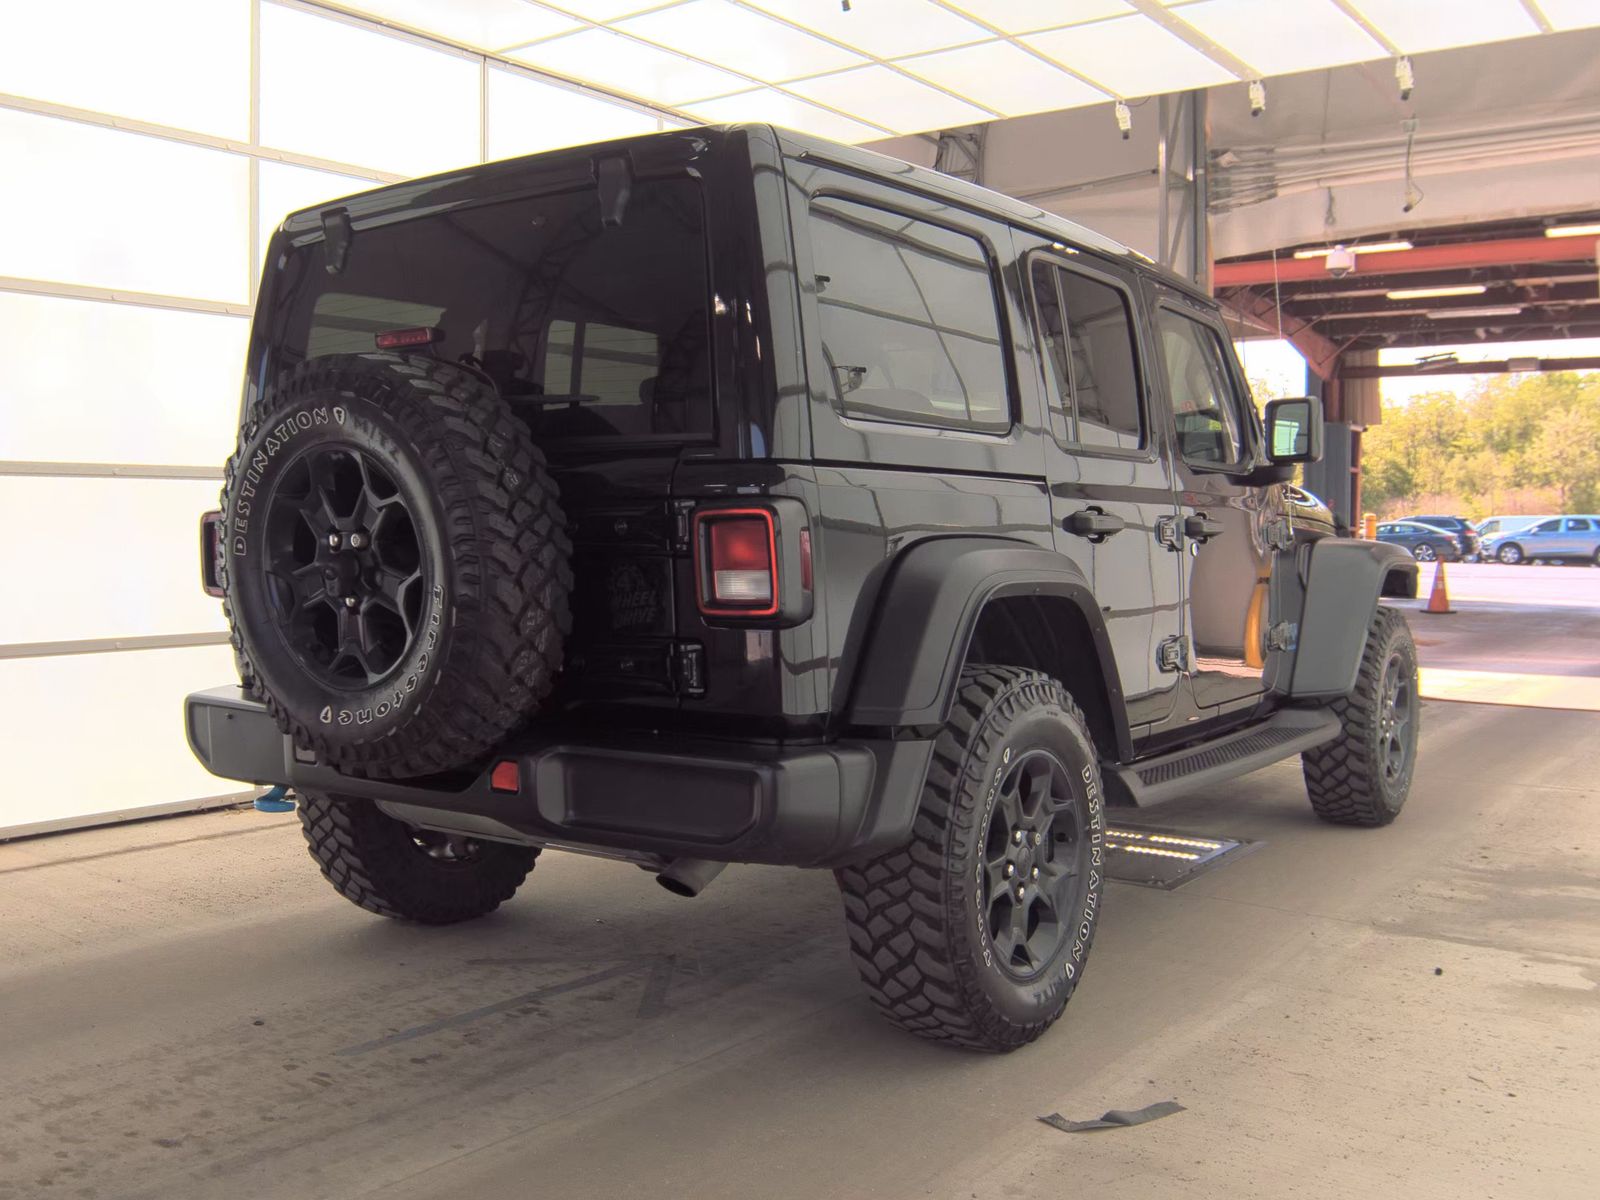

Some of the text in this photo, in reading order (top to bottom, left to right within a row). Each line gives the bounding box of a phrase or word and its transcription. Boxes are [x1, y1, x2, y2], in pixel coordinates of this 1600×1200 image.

[233, 406, 328, 556] DESTINATION
[337, 584, 445, 725] Firestone
[1071, 764, 1103, 963] DESTINATION
